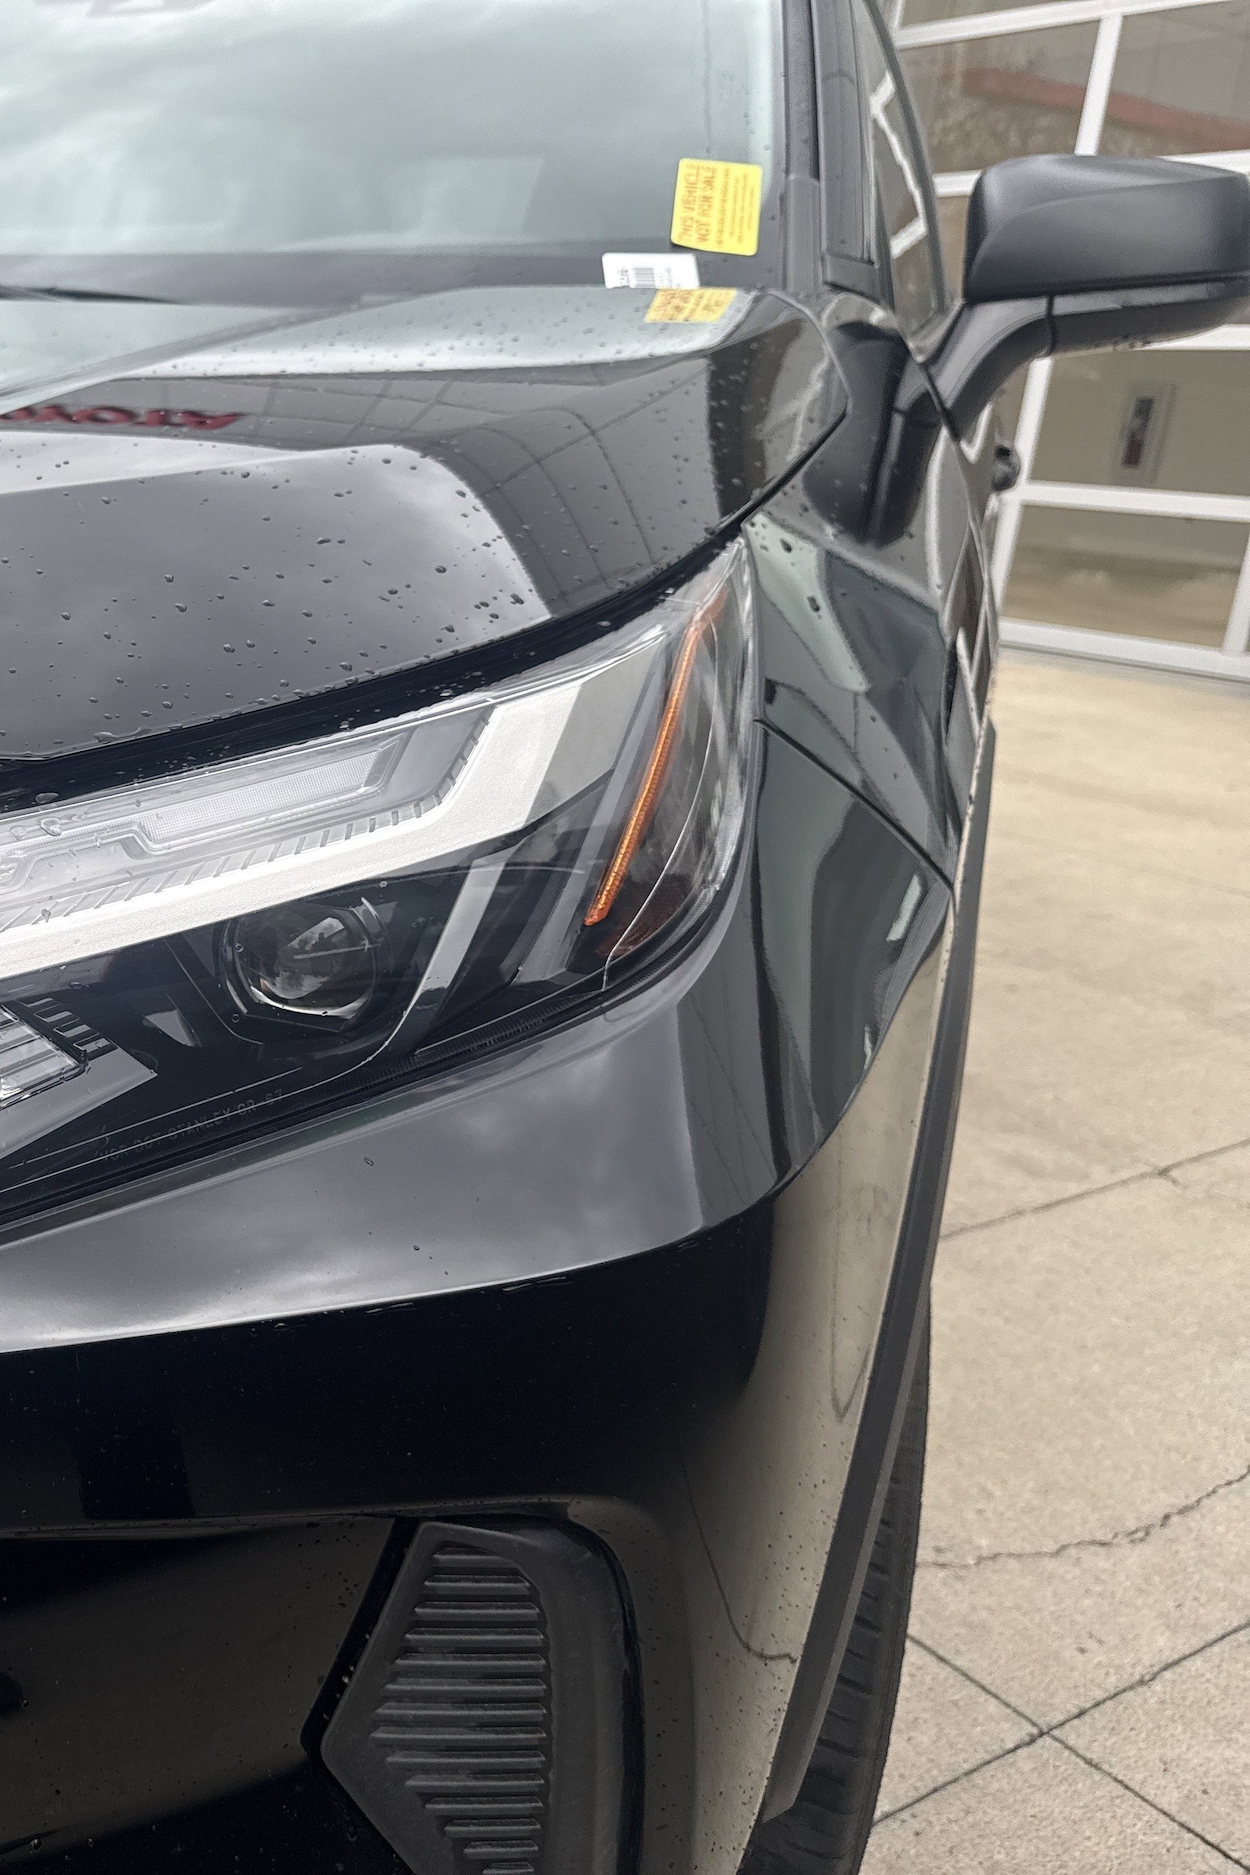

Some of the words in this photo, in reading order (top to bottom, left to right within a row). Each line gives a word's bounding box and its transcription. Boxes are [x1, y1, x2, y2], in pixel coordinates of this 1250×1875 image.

[699, 165, 717, 192] SALE
[133, 1132, 161, 1153] DOT
[168, 1107, 230, 1140] STANLEY
